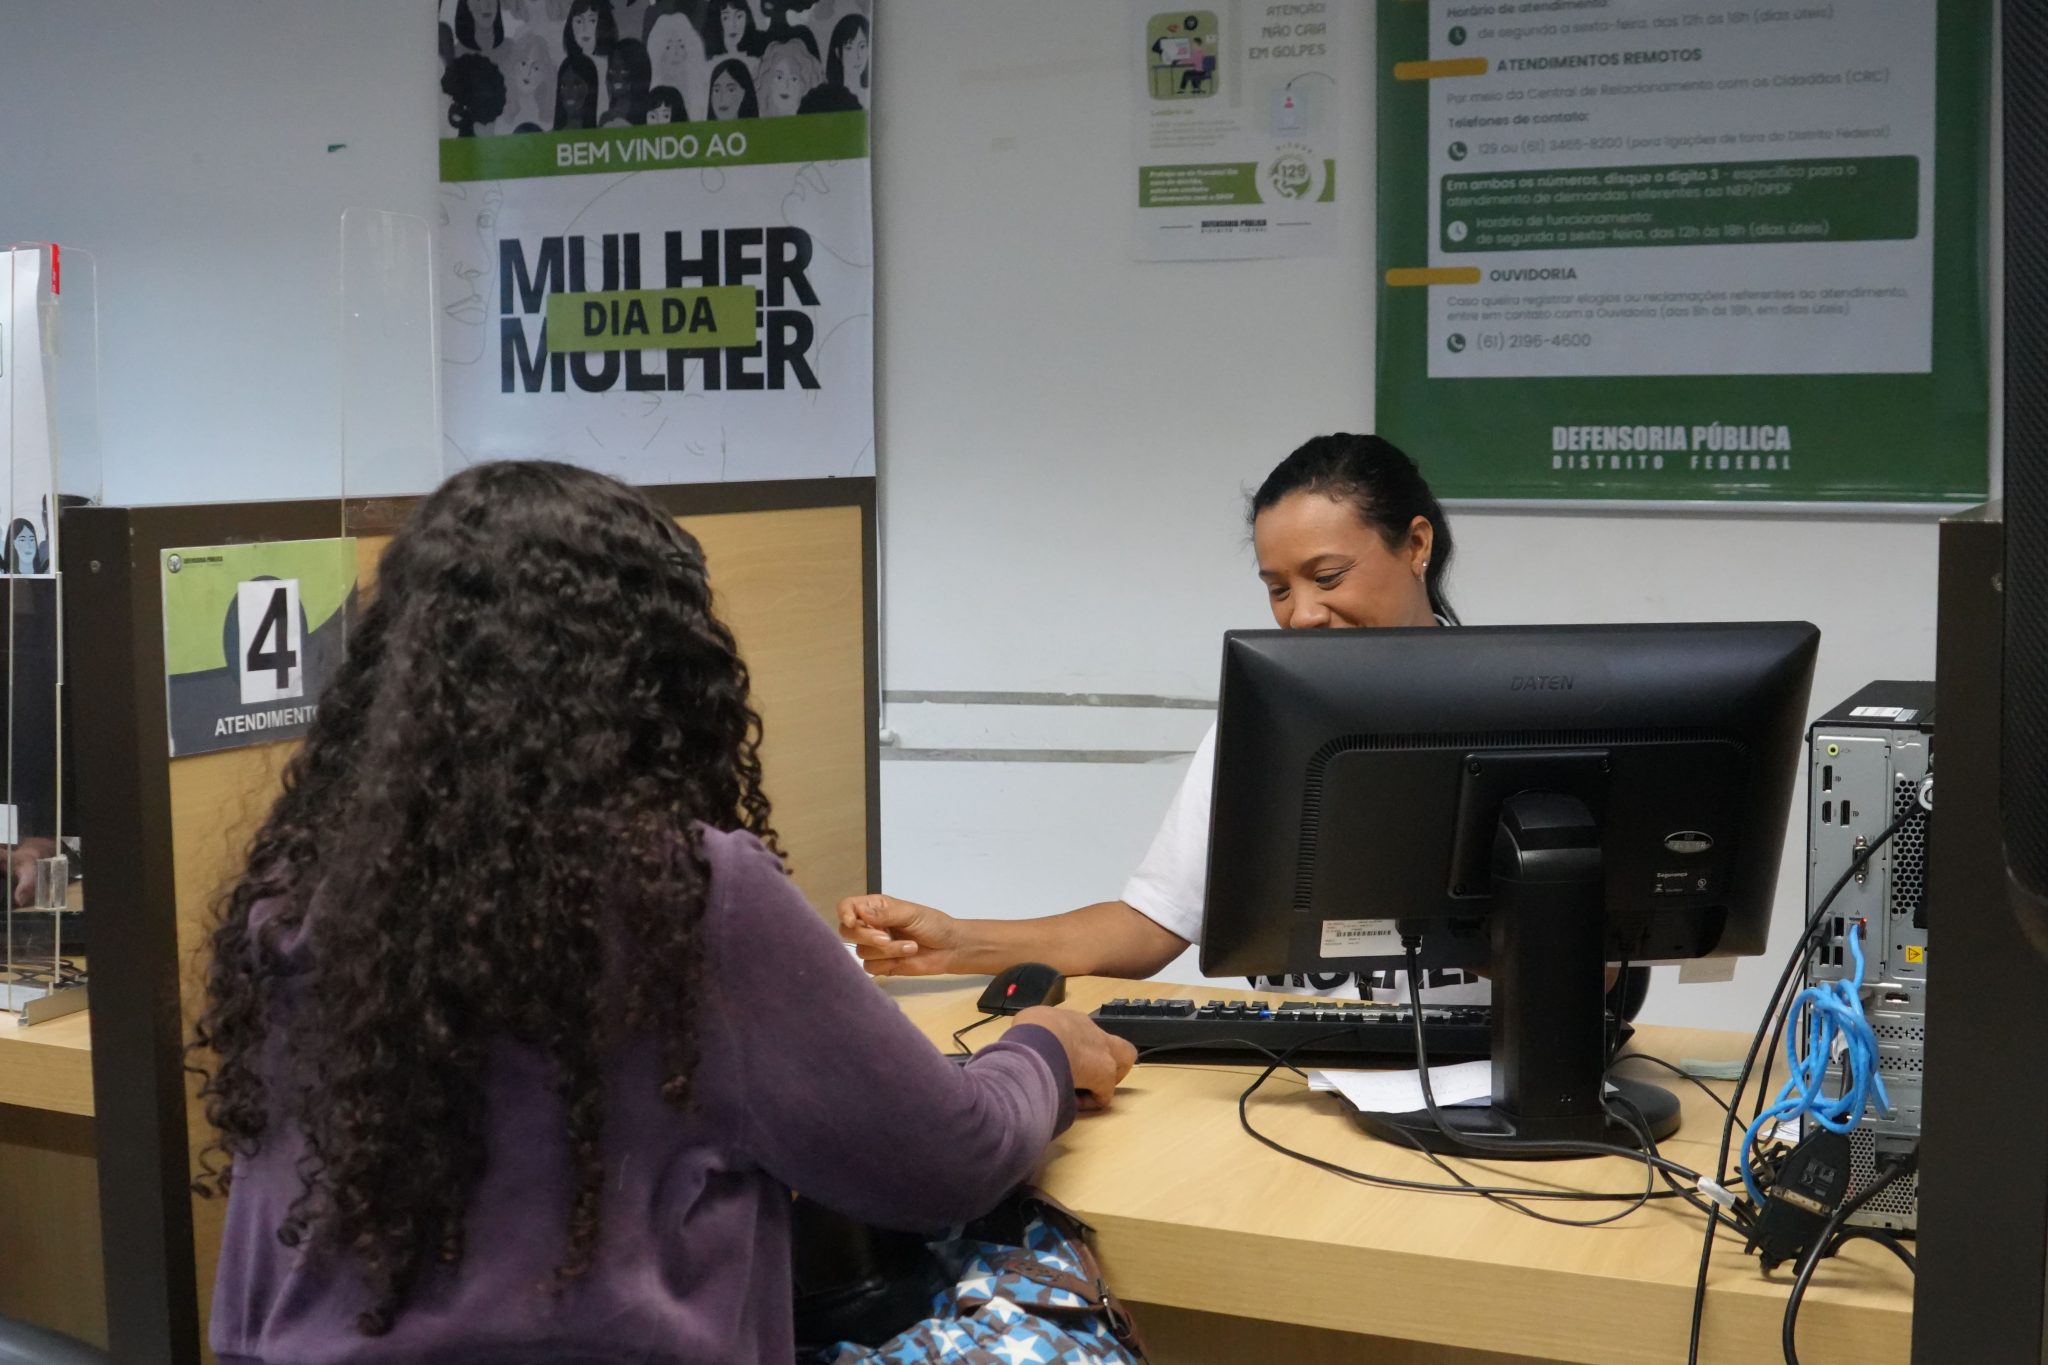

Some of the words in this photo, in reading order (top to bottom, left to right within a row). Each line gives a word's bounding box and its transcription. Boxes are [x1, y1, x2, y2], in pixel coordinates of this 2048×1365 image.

[1499, 4, 1515, 14] de
[1478, 29, 1494, 38] de
[1498, 26, 1556, 40] segunda
[1560, 25, 1570, 34] a
[1653, 17, 1678, 28] das
[1248, 47, 1268, 59] EM
[1272, 44, 1326, 58] GOLPES
[1498, 52, 1619, 71] ATENDIMENTOS
[1623, 48, 1702, 66] REMOTOS
[1447, 92, 1466, 105] Por
[1470, 90, 1502, 102] meio
[1506, 89, 1524, 100] da
[1526, 86, 1576, 100] Central
[1580, 86, 1596, 97] de
[1601, 80, 1713, 95] Relacionamento
[1717, 78, 1748, 89] com
[1448, 114, 1508, 128] Telefones
[1513, 114, 1529, 125] de
[1533, 112, 1589, 124] contato:
[556, 141, 610, 168] BEM
[615, 134, 699, 162] VINDO
[706, 132, 746, 158] AO
[1501, 144, 1518, 154] ou
[1720, 134, 1736, 143] de
[1788, 128, 1832, 140] Distrito
[1447, 180, 1468, 191] Em
[1470, 179, 1516, 190] ambos
[1519, 178, 1534, 188] os
[1604, 172, 1652, 185] disque
[1654, 172, 1664, 182] o
[1667, 168, 1708, 184] dígito
[1711, 169, 1718, 180] 3
[1808, 166, 1844, 179] para
[1846, 166, 1857, 175] o
[1447, 194, 1530, 207] atendimento
[1533, 193, 1551, 204] de
[1554, 190, 1628, 203] demandas
[1704, 187, 1724, 197] ao
[1726, 182, 1793, 198] NEP/DPDF
[1477, 215, 1523, 228] Horário
[1526, 215, 1543, 226] de
[1477, 234, 1493, 245] de
[1496, 231, 1554, 247] segunda
[1558, 233, 1567, 241] a
[1650, 228, 1674, 239] das
[1679, 226, 1700, 237] 12h
[1724, 224, 1746, 236] 18h
[1749, 222, 1786, 238] (dias
[1490, 268, 1577, 282] OUVIDORIA
[1447, 296, 1479, 306] Caso
[1481, 294, 1520, 308] queira
[1522, 294, 1573, 307] registrar
[1577, 294, 1621, 305] elogios
[1624, 294, 1641, 302] ou
[1644, 290, 1727, 303] reclamações
[1730, 289, 1794, 300] referentes
[1798, 290, 1818, 300] ao
[584, 298, 650, 336] DIA
[662, 296, 718, 334] DA
[1447, 310, 1479, 320] entre
[1482, 310, 1500, 320] em
[1504, 308, 1552, 320] contato
[1554, 309, 1583, 319] com
[1597, 306, 1657, 319] Ouvidoria
[1661, 303, 1689, 320] (das
[1756, 305, 1779, 315] em
[1782, 303, 1809, 314] dias
[501, 310, 821, 394] MULHER
[1476, 332, 1505, 351] (61)
[1509, 333, 1591, 348] 2196-4600
[1552, 425, 1688, 451] DEFENSORIA
[1692, 421, 1791, 451] PÚBLICA
[1552, 455, 1664, 470] DISTRITO
[1691, 455, 1791, 470] FEDERAL
[247, 588, 297, 689] 4
[1511, 675, 1574, 691] DATEN
